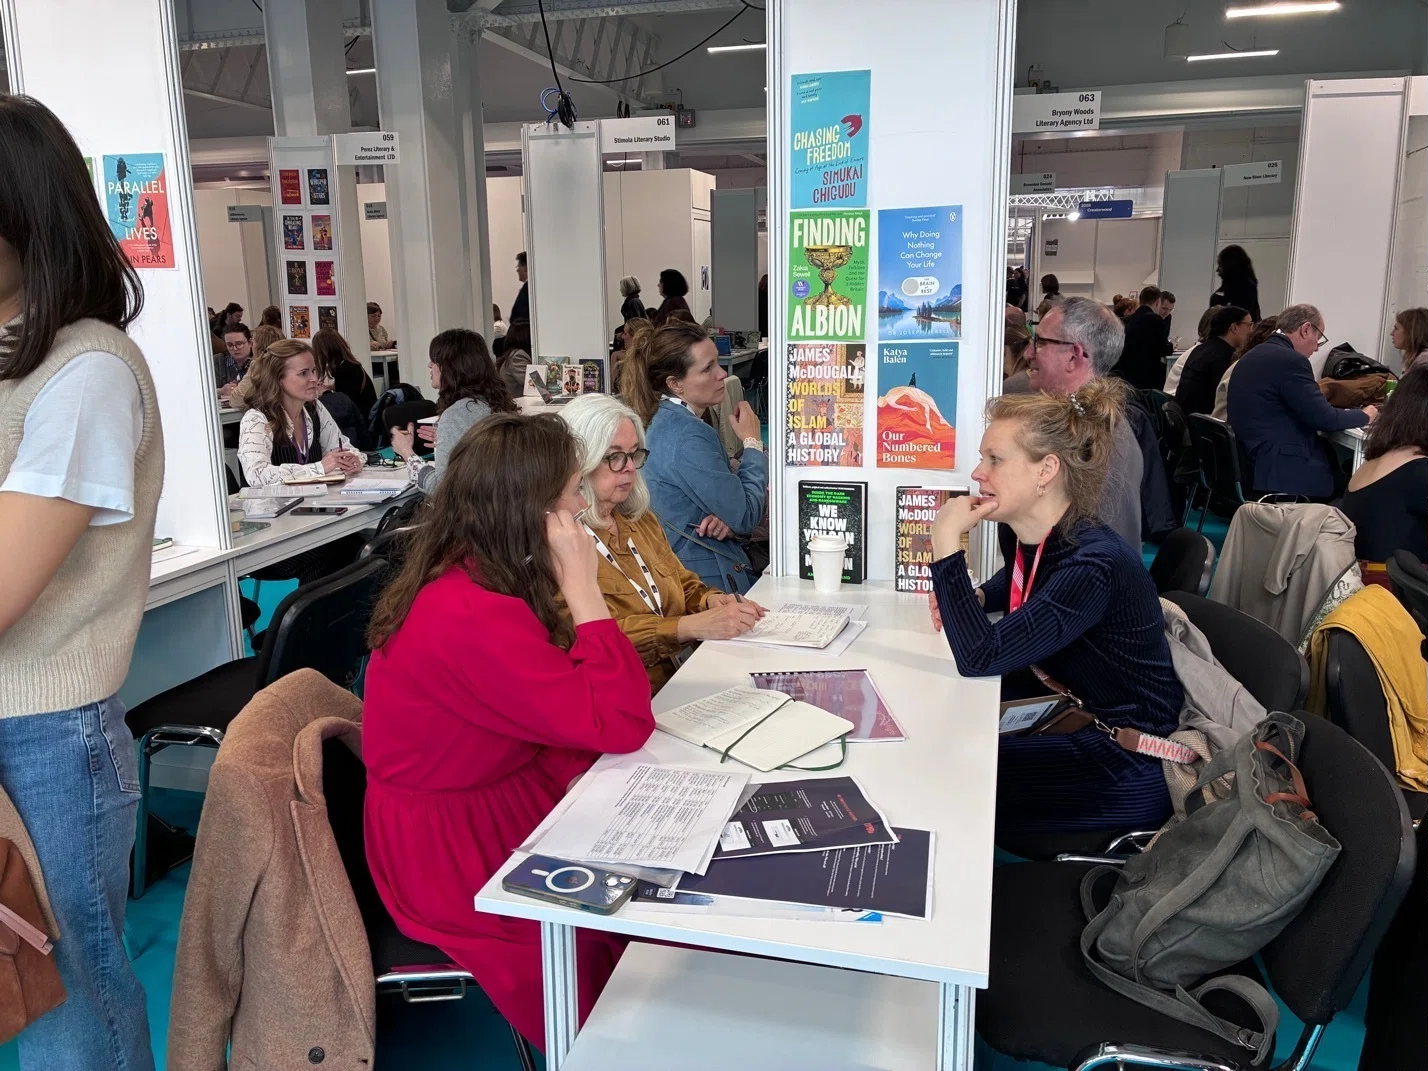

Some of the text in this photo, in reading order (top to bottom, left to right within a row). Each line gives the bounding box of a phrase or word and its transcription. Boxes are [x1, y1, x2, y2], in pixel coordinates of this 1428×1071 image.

[1078, 94, 1095, 102] 063
[1052, 108, 1094, 117] Bryony Woods
[657, 118, 670, 126] 061
[1036, 120, 1060, 128] Literary
[1060, 119, 1082, 127] Agency
[382, 134, 394, 142] 059
[634, 136, 653, 144] Literary
[794, 124, 840, 151] CHASING
[807, 141, 851, 166] FREEDOM
[823, 164, 863, 186] SIMUKAI
[108, 181, 165, 195] PARALLEL
[812, 182, 856, 204] CHIGUDU
[125, 227, 158, 240] LIVES
[793, 217, 866, 248] FINDING
[902, 230, 940, 240] Why Doing
[907, 241, 935, 250] Nothing
[142, 255, 167, 264] PEARS
[915, 251, 942, 260] Change
[792, 264, 808, 272] Zakia
[907, 260, 935, 269] Your Life
[790, 304, 862, 337] ALBION
[788, 347, 830, 362] JAMES
[884, 348, 908, 358] Katya
[884, 356, 907, 364] Balen
[789, 365, 863, 379] McDOUGALL
[788, 382, 840, 396] WORLDS
[789, 398, 804, 412] OF
[788, 415, 826, 429] ISLAM
[788, 432, 846, 446] A GLOBAL
[882, 430, 905, 441] Our
[882, 442, 940, 453] Numbered
[788, 448, 840, 462] HISTORY
[882, 452, 917, 463] Bones
[898, 494, 936, 507] JAMES
[818, 504, 838, 518] WE
[899, 508, 939, 521] McDOU
[810, 516, 848, 531] KNOW
[900, 522, 932, 535] WORL
[898, 536, 912, 548] OF
[898, 550, 932, 563] ISLAM
[898, 564, 932, 578] A GLO
